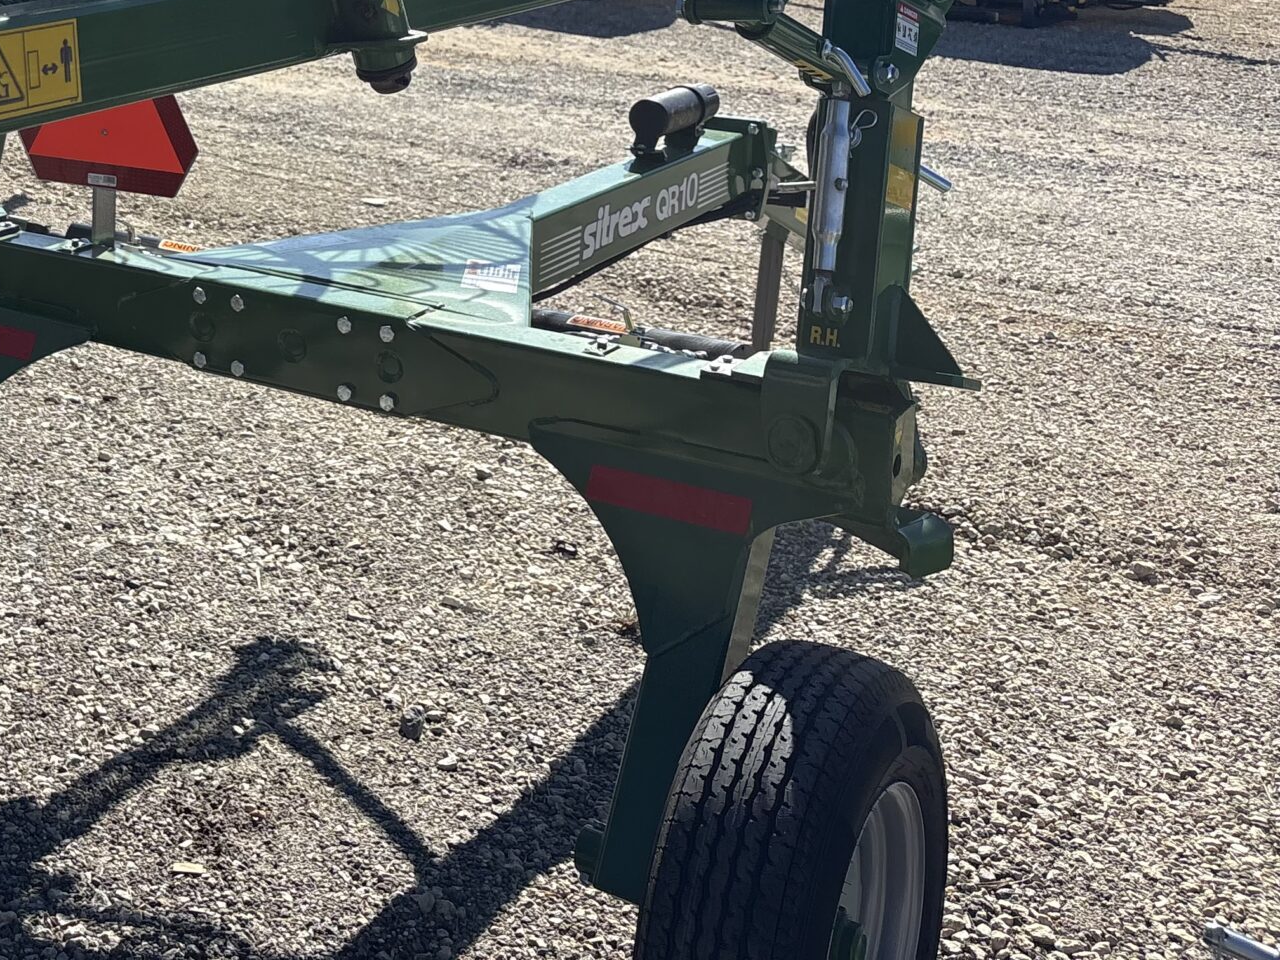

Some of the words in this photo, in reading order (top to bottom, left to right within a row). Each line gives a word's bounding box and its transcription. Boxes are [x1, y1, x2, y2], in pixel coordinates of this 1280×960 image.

[582, 195, 652, 260] sitrex
[655, 172, 698, 221] QR10
[810, 325, 840, 348] R.H.
